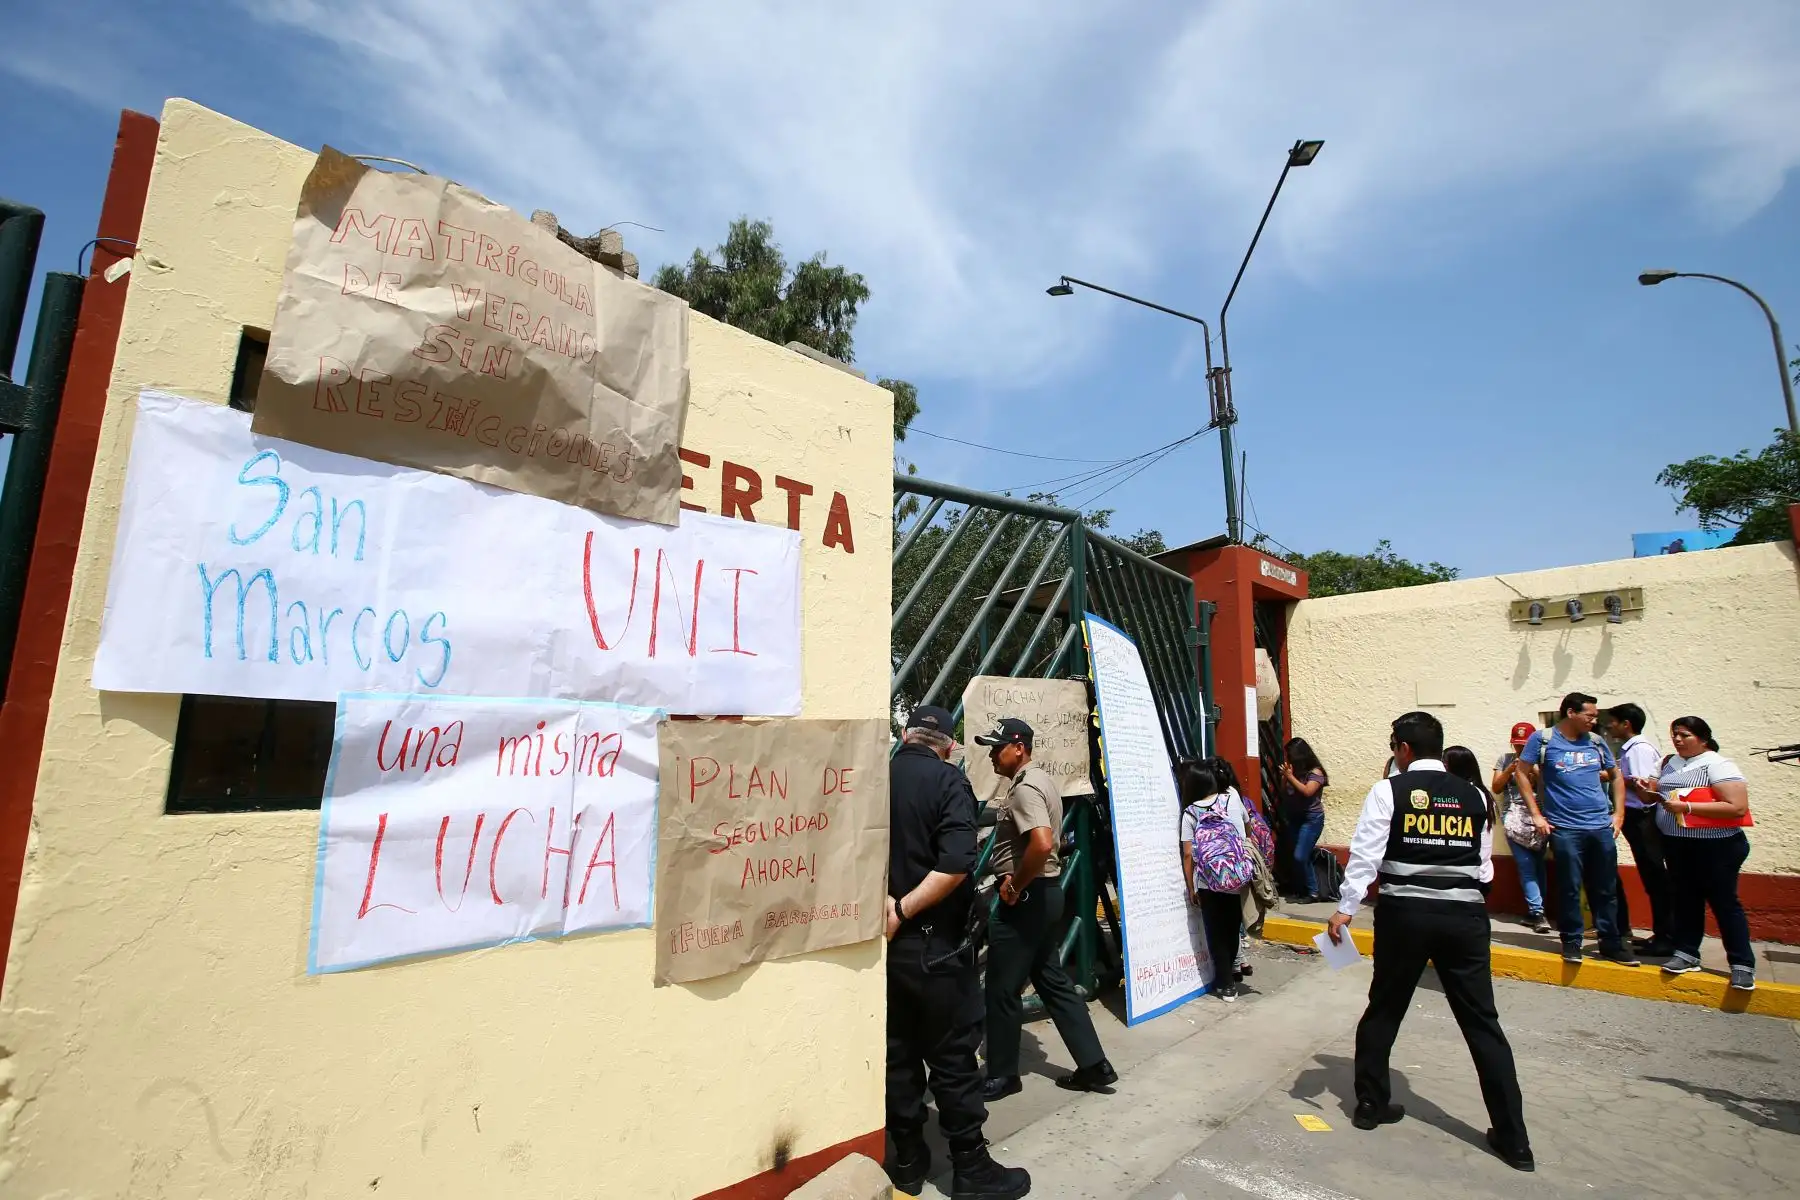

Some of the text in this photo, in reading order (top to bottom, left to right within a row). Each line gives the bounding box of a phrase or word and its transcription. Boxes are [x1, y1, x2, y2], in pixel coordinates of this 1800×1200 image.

[341, 263, 599, 363] DE VERANO
[228, 450, 366, 561] San
[197, 561, 452, 688] Marcos
[584, 530, 758, 659] UNI
[496, 720, 623, 778] misma
[823, 767, 855, 796] DE
[357, 806, 620, 919] LUCHA
[1403, 813, 1474, 838] POLICÍA
[741, 853, 816, 889] AHORA!
[764, 903, 860, 930] BARRAGAN!
